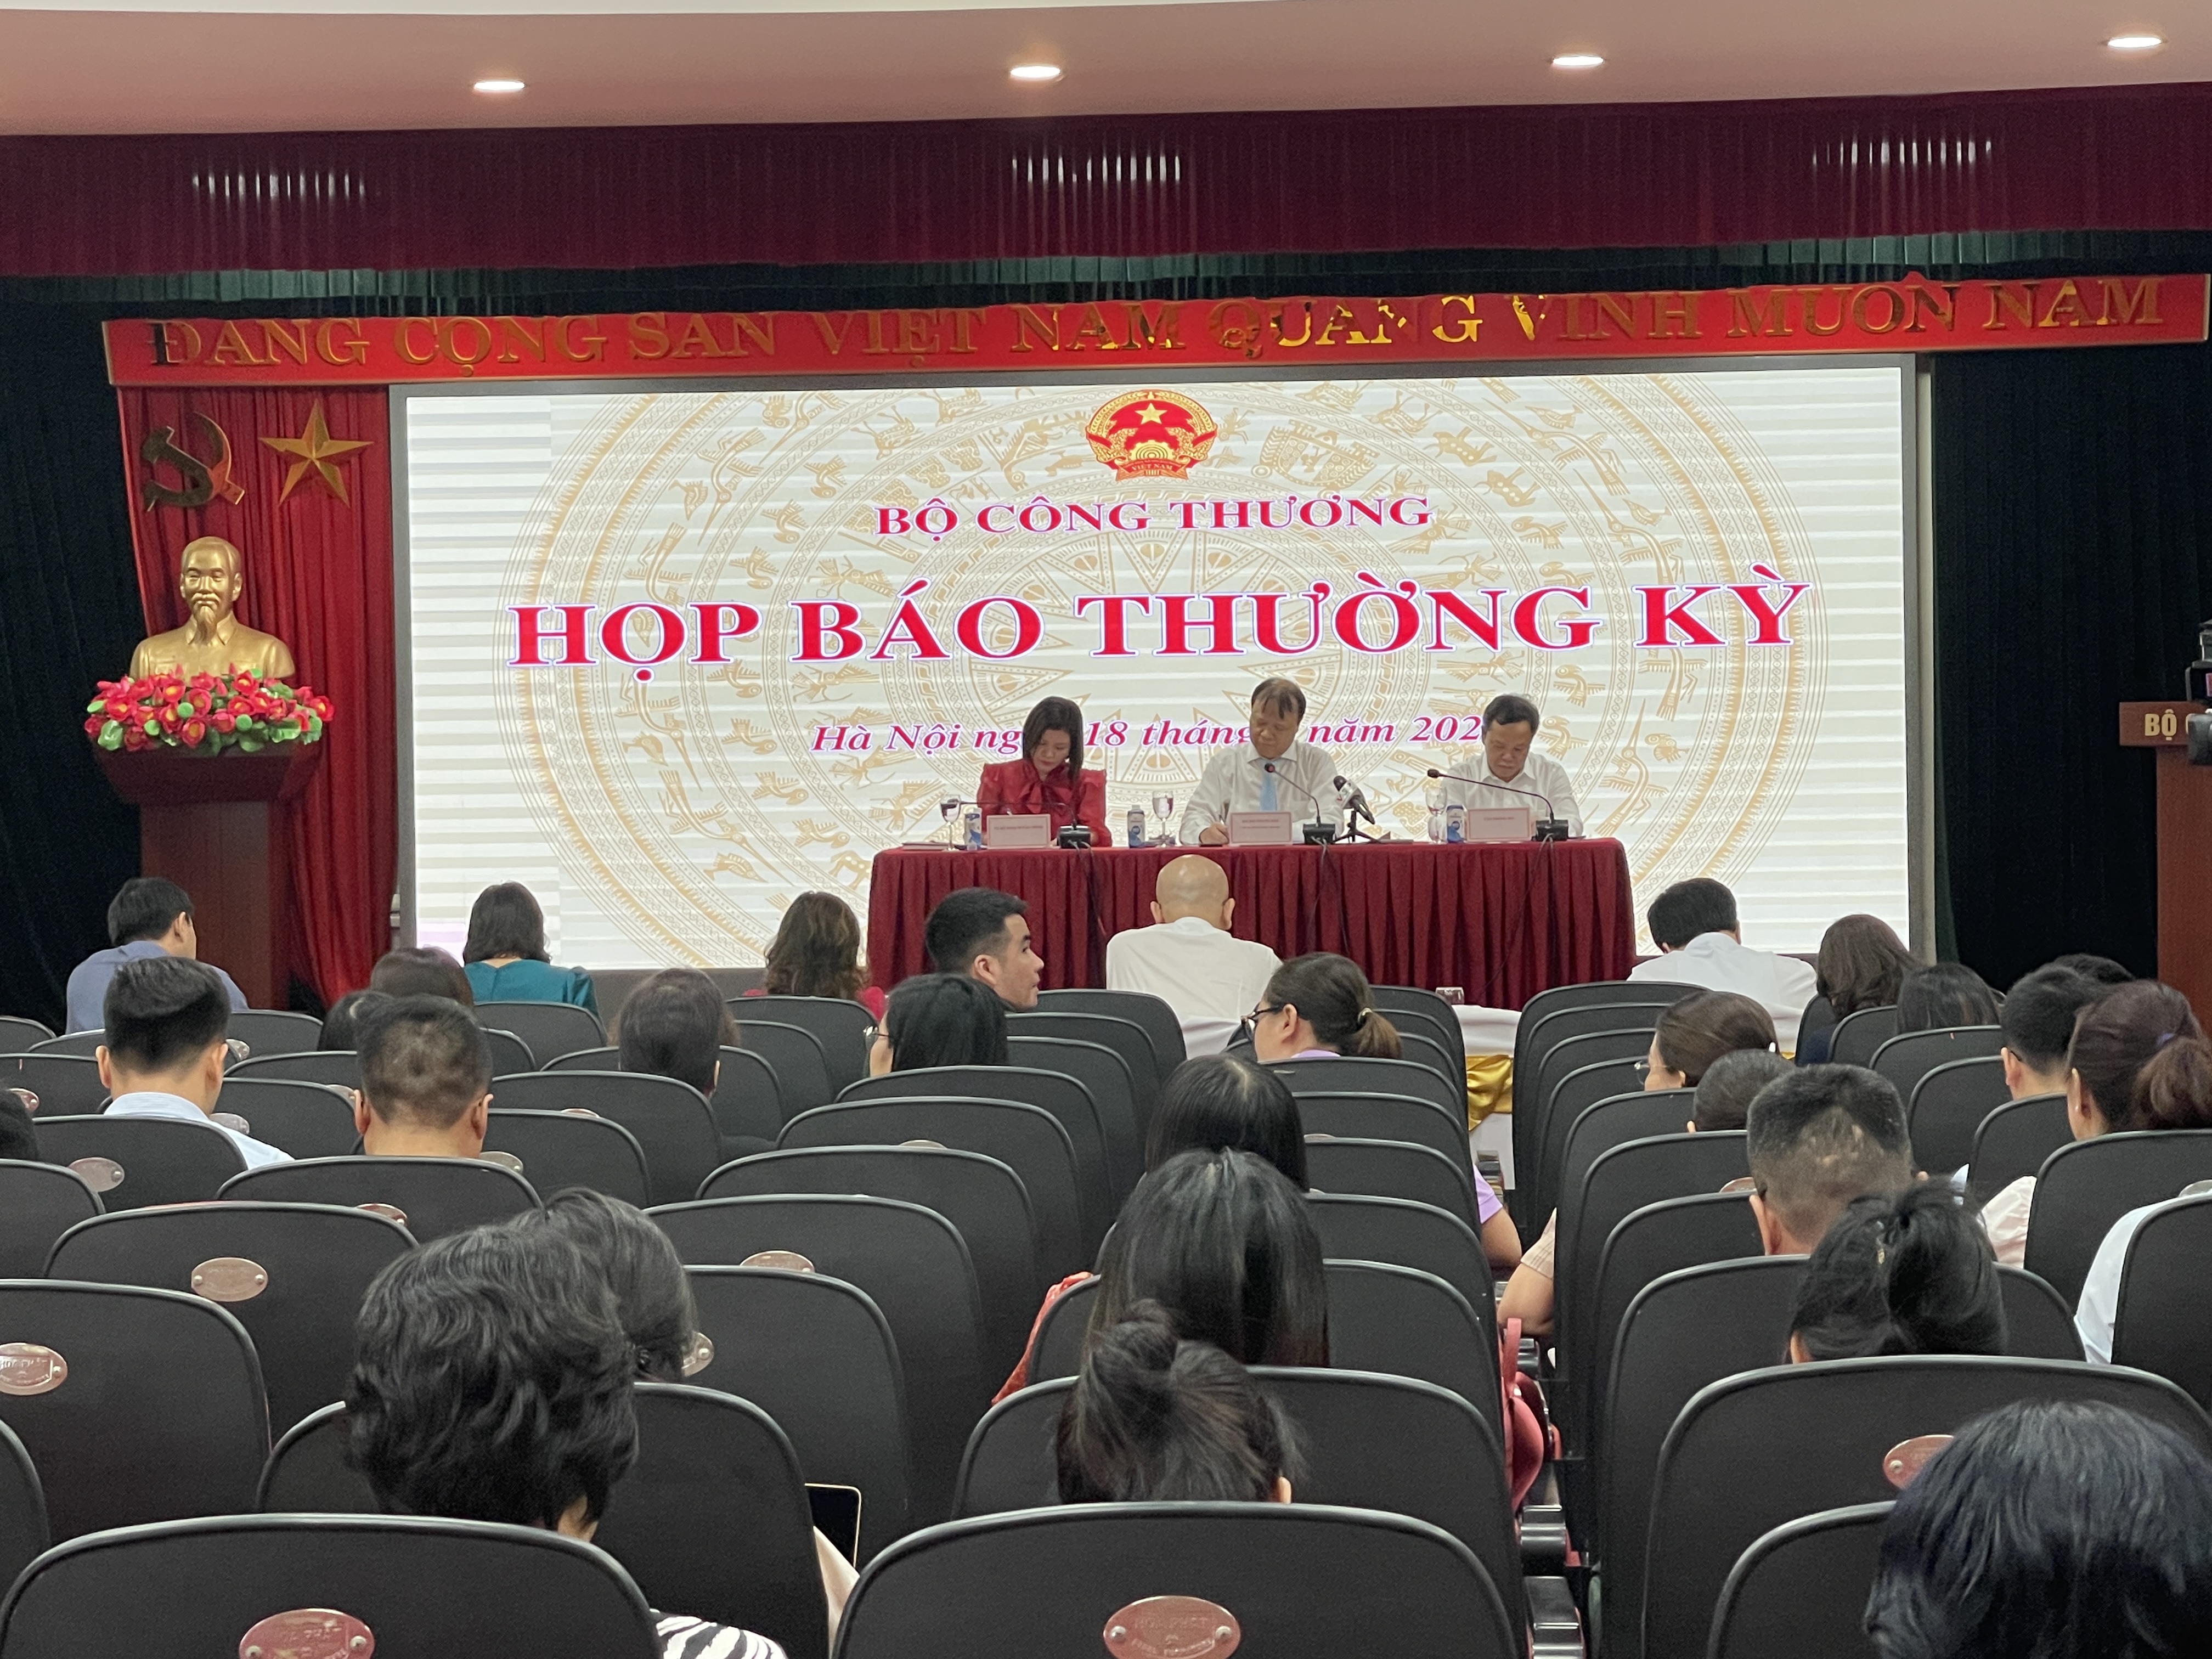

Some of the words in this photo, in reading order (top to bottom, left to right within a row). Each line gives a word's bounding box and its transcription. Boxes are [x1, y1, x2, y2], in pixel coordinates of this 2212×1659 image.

[1008, 300, 1186, 352] NAM
[1208, 294, 1483, 358] QUANG
[1505, 290, 1703, 341] VINH
[877, 496, 958, 541] BỘ
[976, 495, 1149, 533] CÔNG
[1169, 494, 1429, 529] THƯƠNG
[508, 602, 759, 681] HỌP
[791, 579, 1041, 662] BÁO
[1075, 571, 1598, 656] THƯỜNG
[1634, 564, 1809, 647] KỲ
[811, 725, 871, 751] Hà
[887, 722, 961, 755] Nội
[973, 730, 1023, 754] ng
[1084, 721, 1128, 746] 18
[1307, 719, 1395, 744] năm
[1409, 715, 1482, 741] 202
[2144, 709, 2177, 741] BỘ
